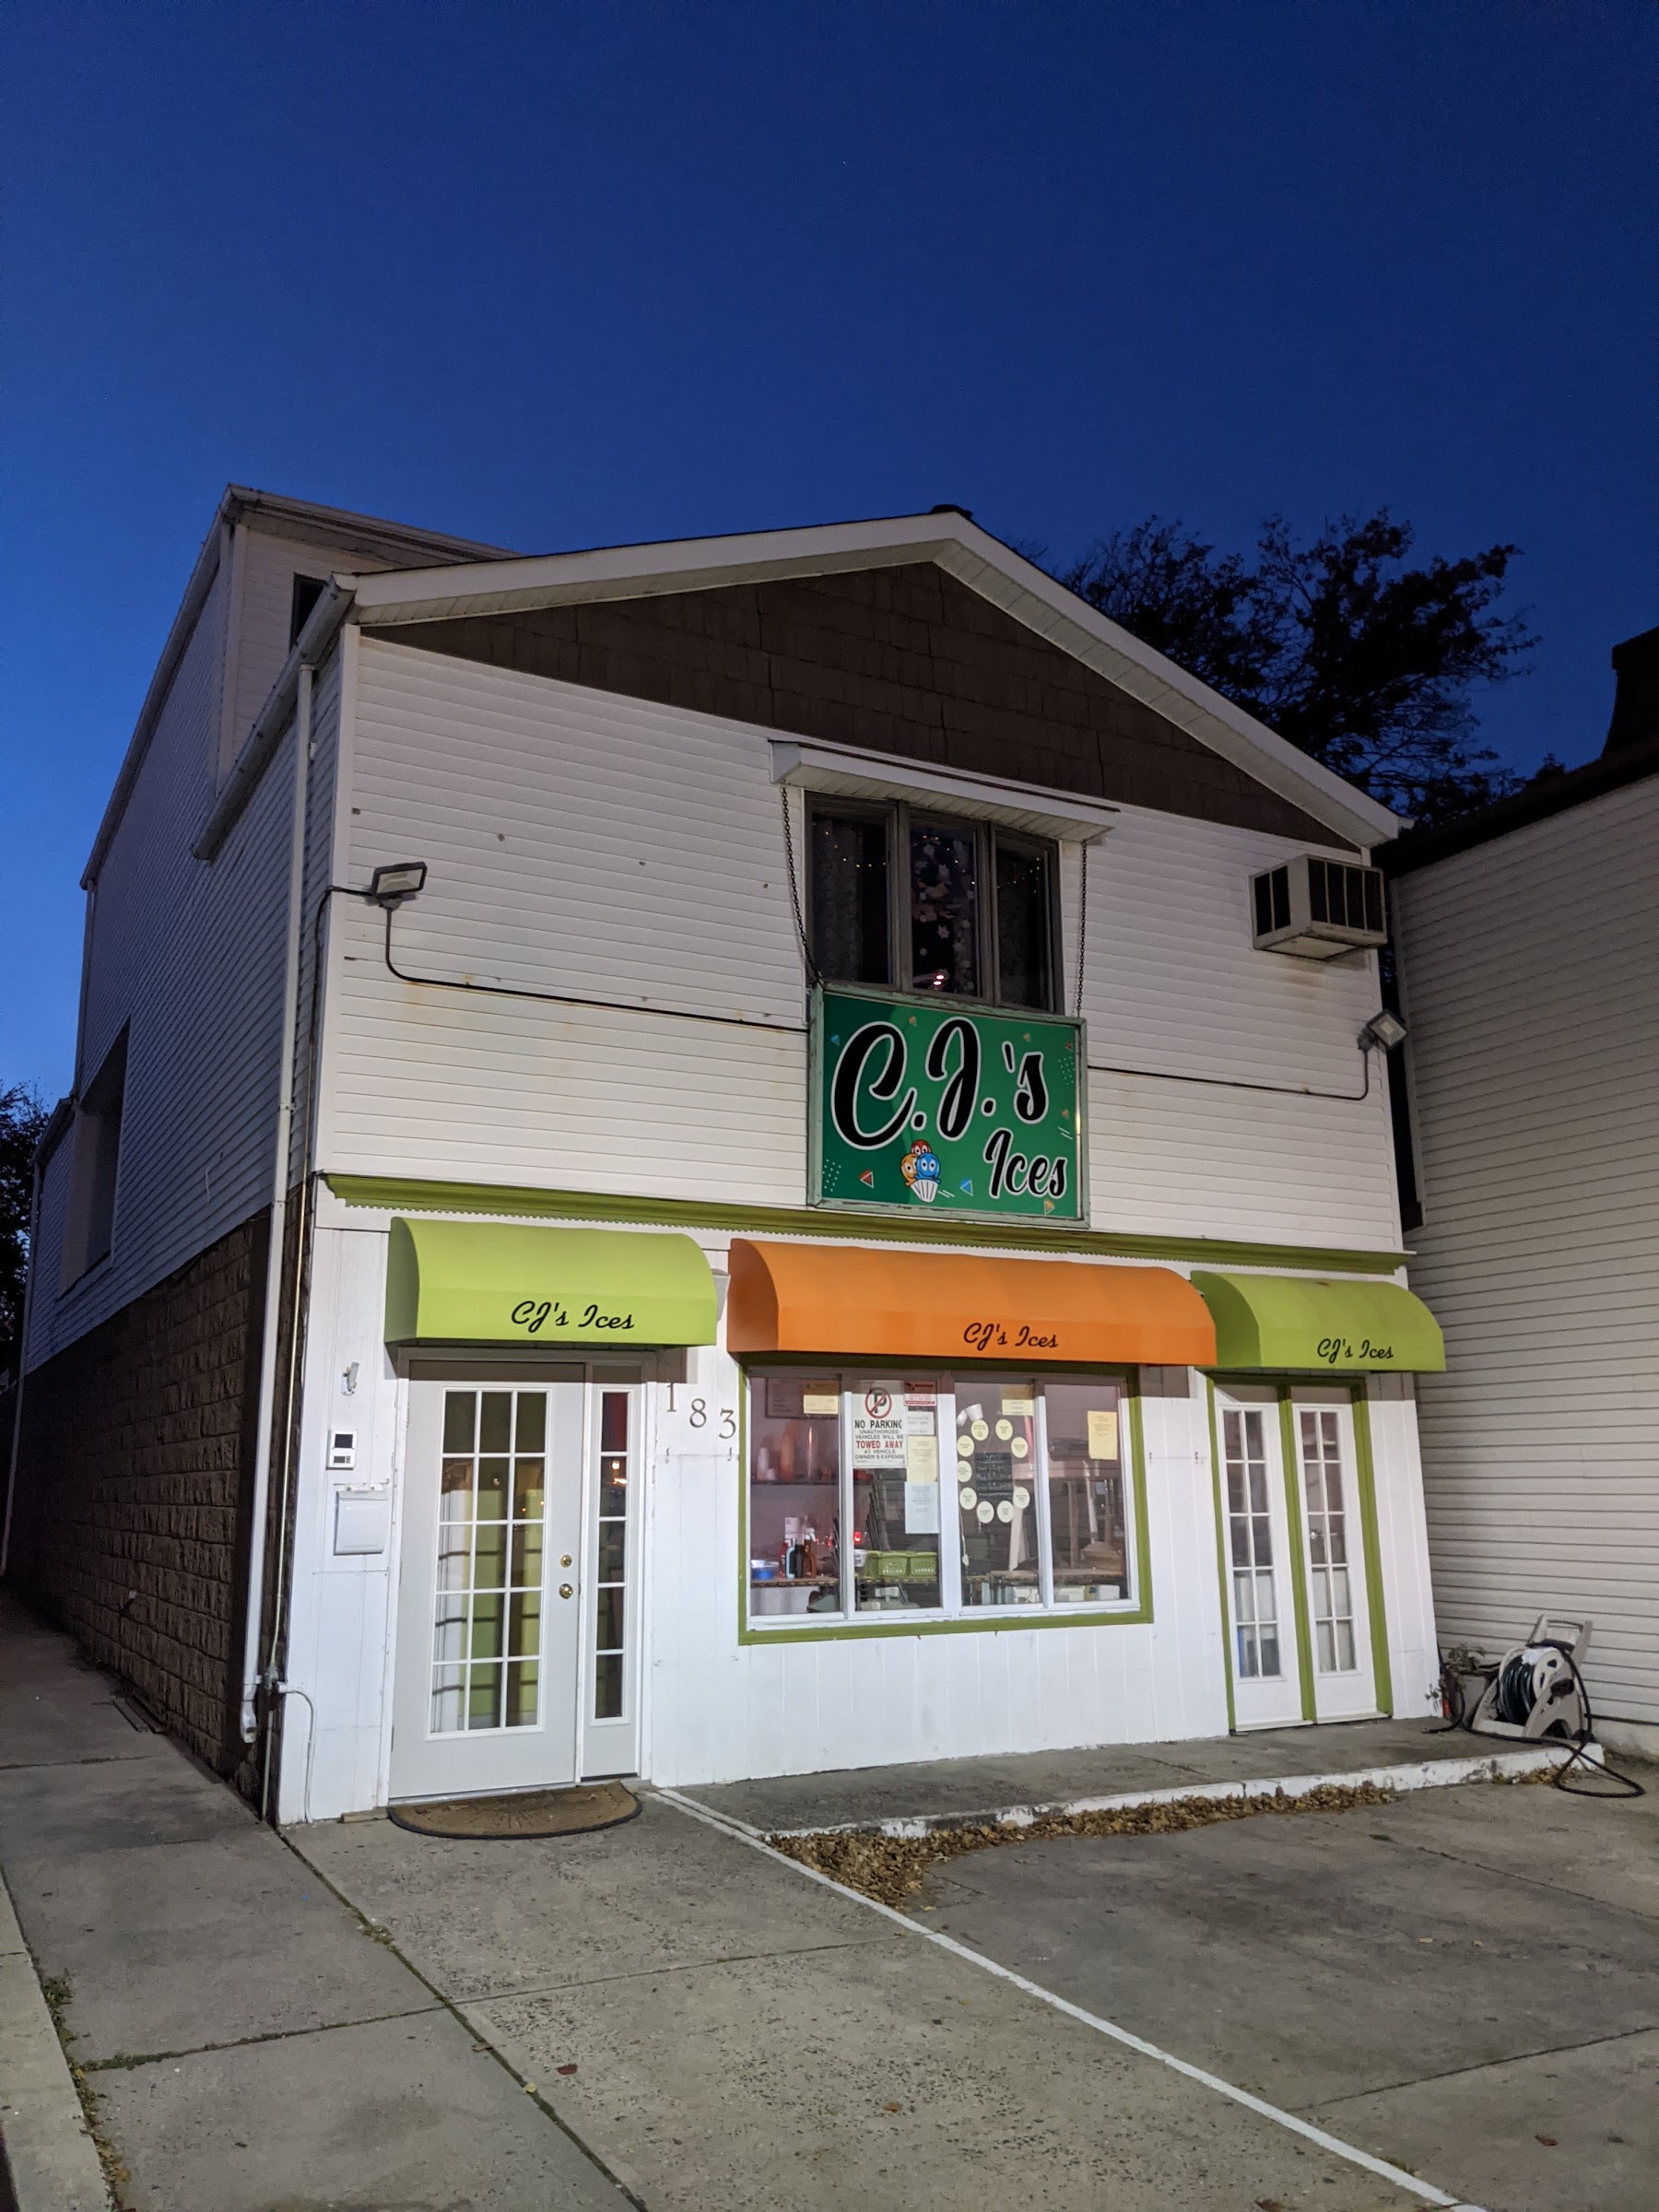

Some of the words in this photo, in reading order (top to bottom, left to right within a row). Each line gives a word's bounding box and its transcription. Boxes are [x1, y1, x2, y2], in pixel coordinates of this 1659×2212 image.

[830, 1016, 1050, 1151] C.J.'s
[982, 1127, 1068, 1199] Ices
[511, 1300, 570, 1334] CJ's
[578, 1304, 635, 1329] Ices
[963, 1322, 1008, 1351] CJ's
[1015, 1325, 1059, 1347] Ices
[1317, 1338, 1353, 1364] CJ's
[1359, 1339, 1394, 1359] Ices
[666, 1382, 736, 1440] 183
[854, 1419, 865, 1429] NO
[855, 1440, 881, 1449] TOWED
[885, 1440, 903, 1449] AWAY
